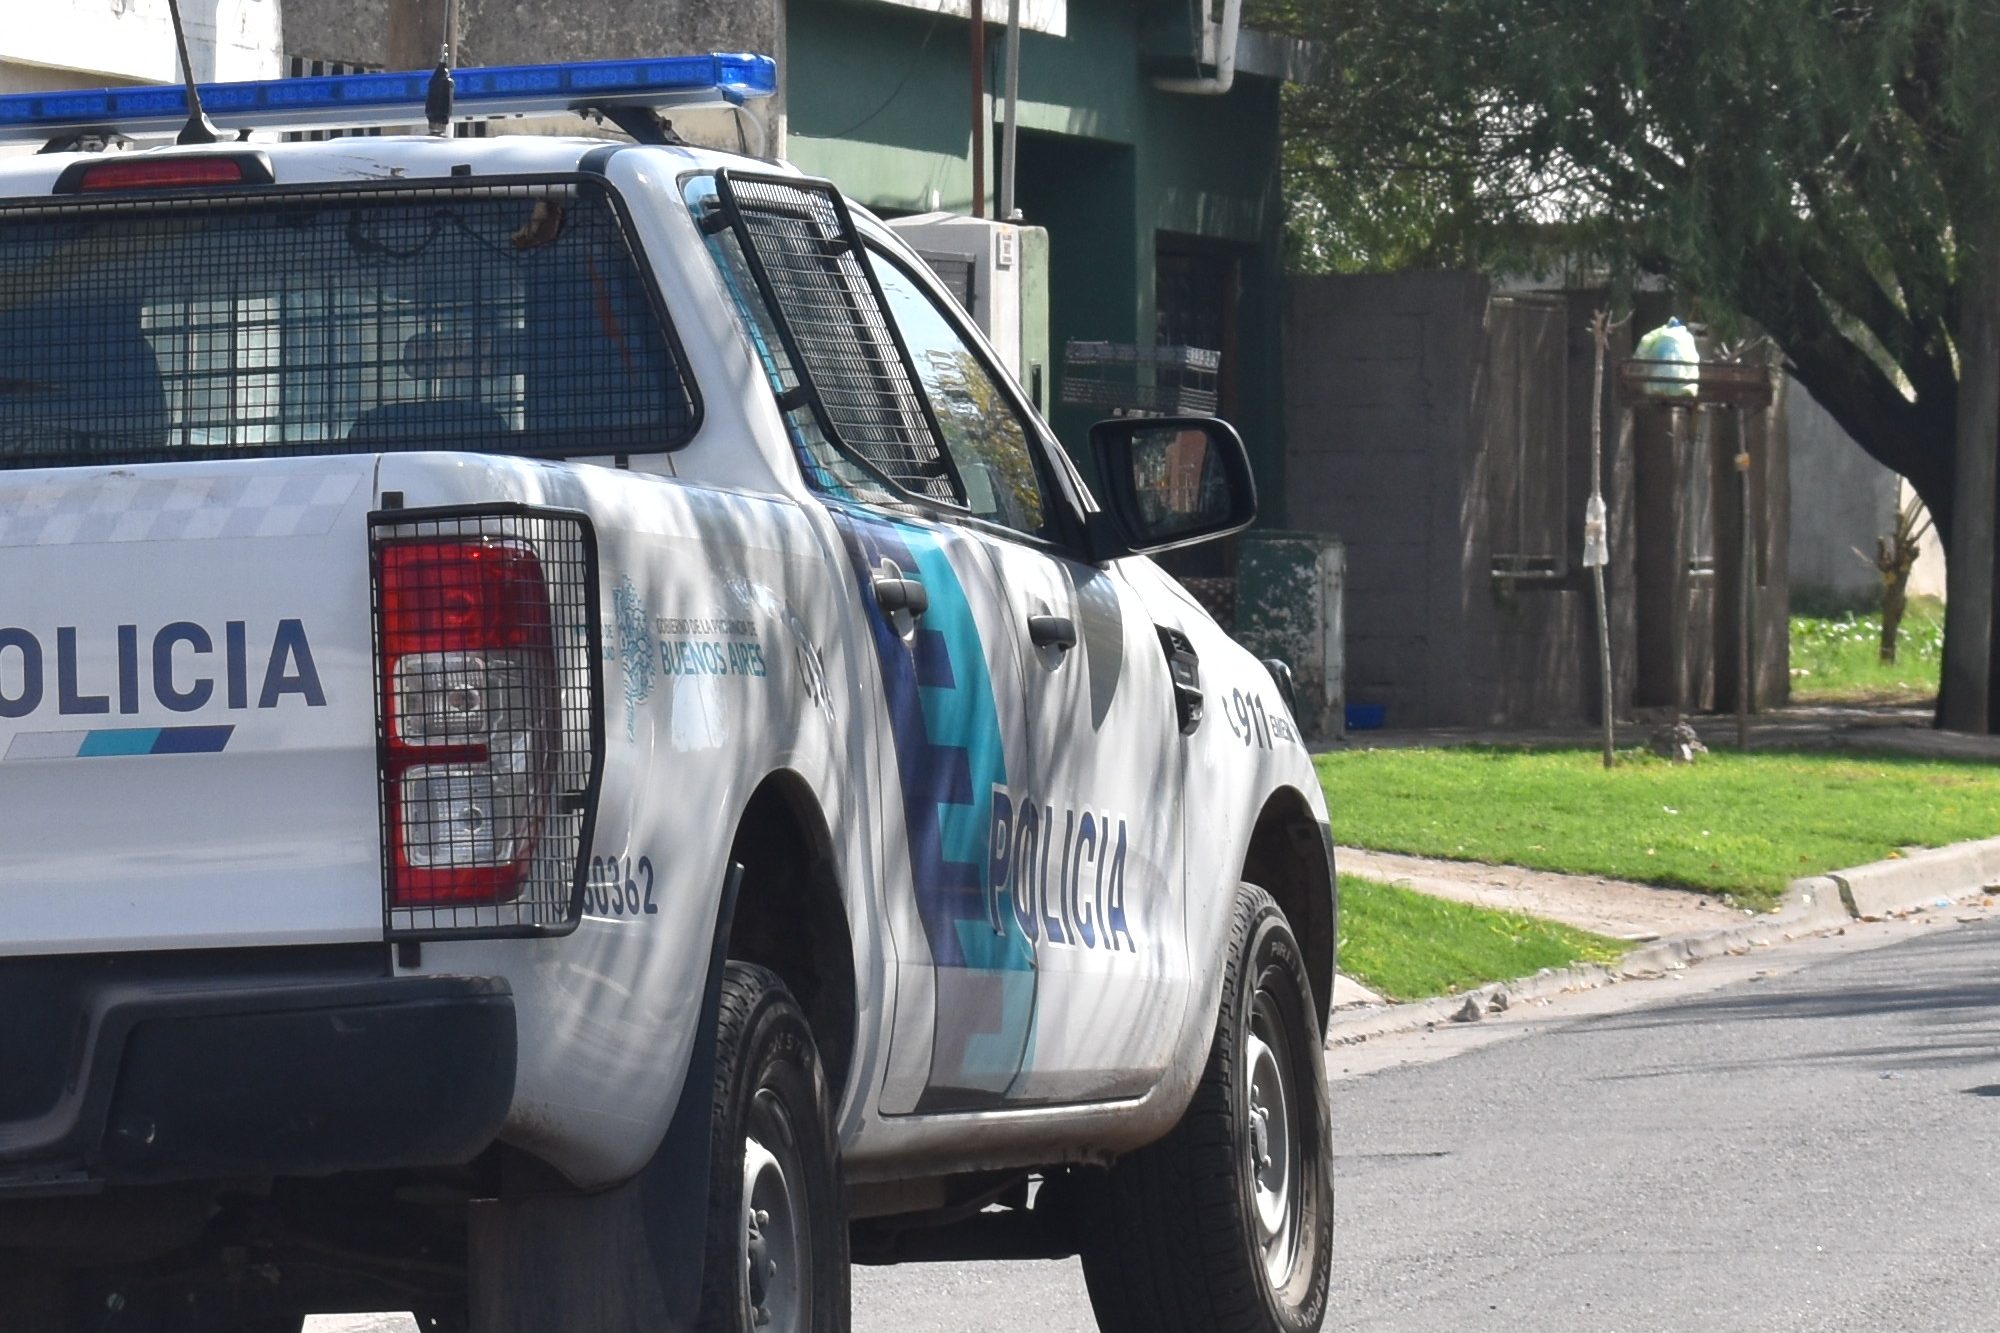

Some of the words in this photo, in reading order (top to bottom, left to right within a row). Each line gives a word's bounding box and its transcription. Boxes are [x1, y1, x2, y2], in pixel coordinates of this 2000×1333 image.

[660, 641, 727, 675] BUENOS
[728, 642, 767, 677] AIRES
[1232, 687, 1274, 751] 911
[988, 783, 1136, 954] POLICIA
